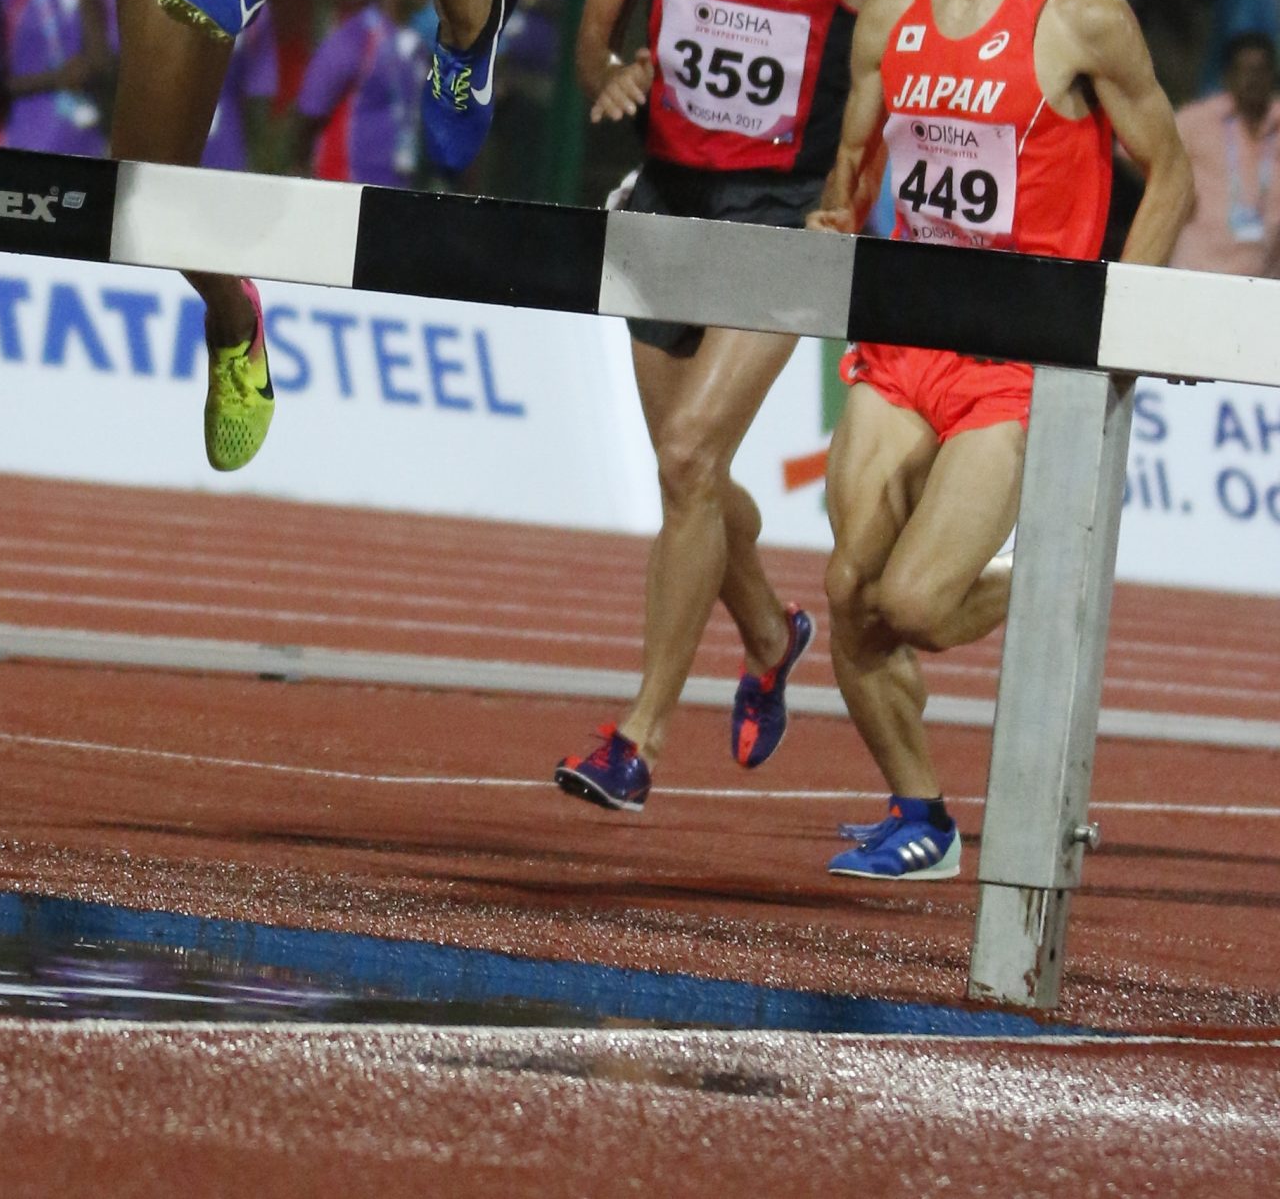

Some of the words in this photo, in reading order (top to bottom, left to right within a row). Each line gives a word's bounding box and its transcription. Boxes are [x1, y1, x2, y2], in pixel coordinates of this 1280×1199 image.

[695, 3, 772, 35] ODISHA
[674, 39, 785, 106] 359
[893, 75, 1006, 114] JAPAN
[736, 114, 763, 130] 2017
[911, 120, 979, 147] ODISHA
[899, 160, 998, 223] 449
[267, 305, 526, 418] STEEL
